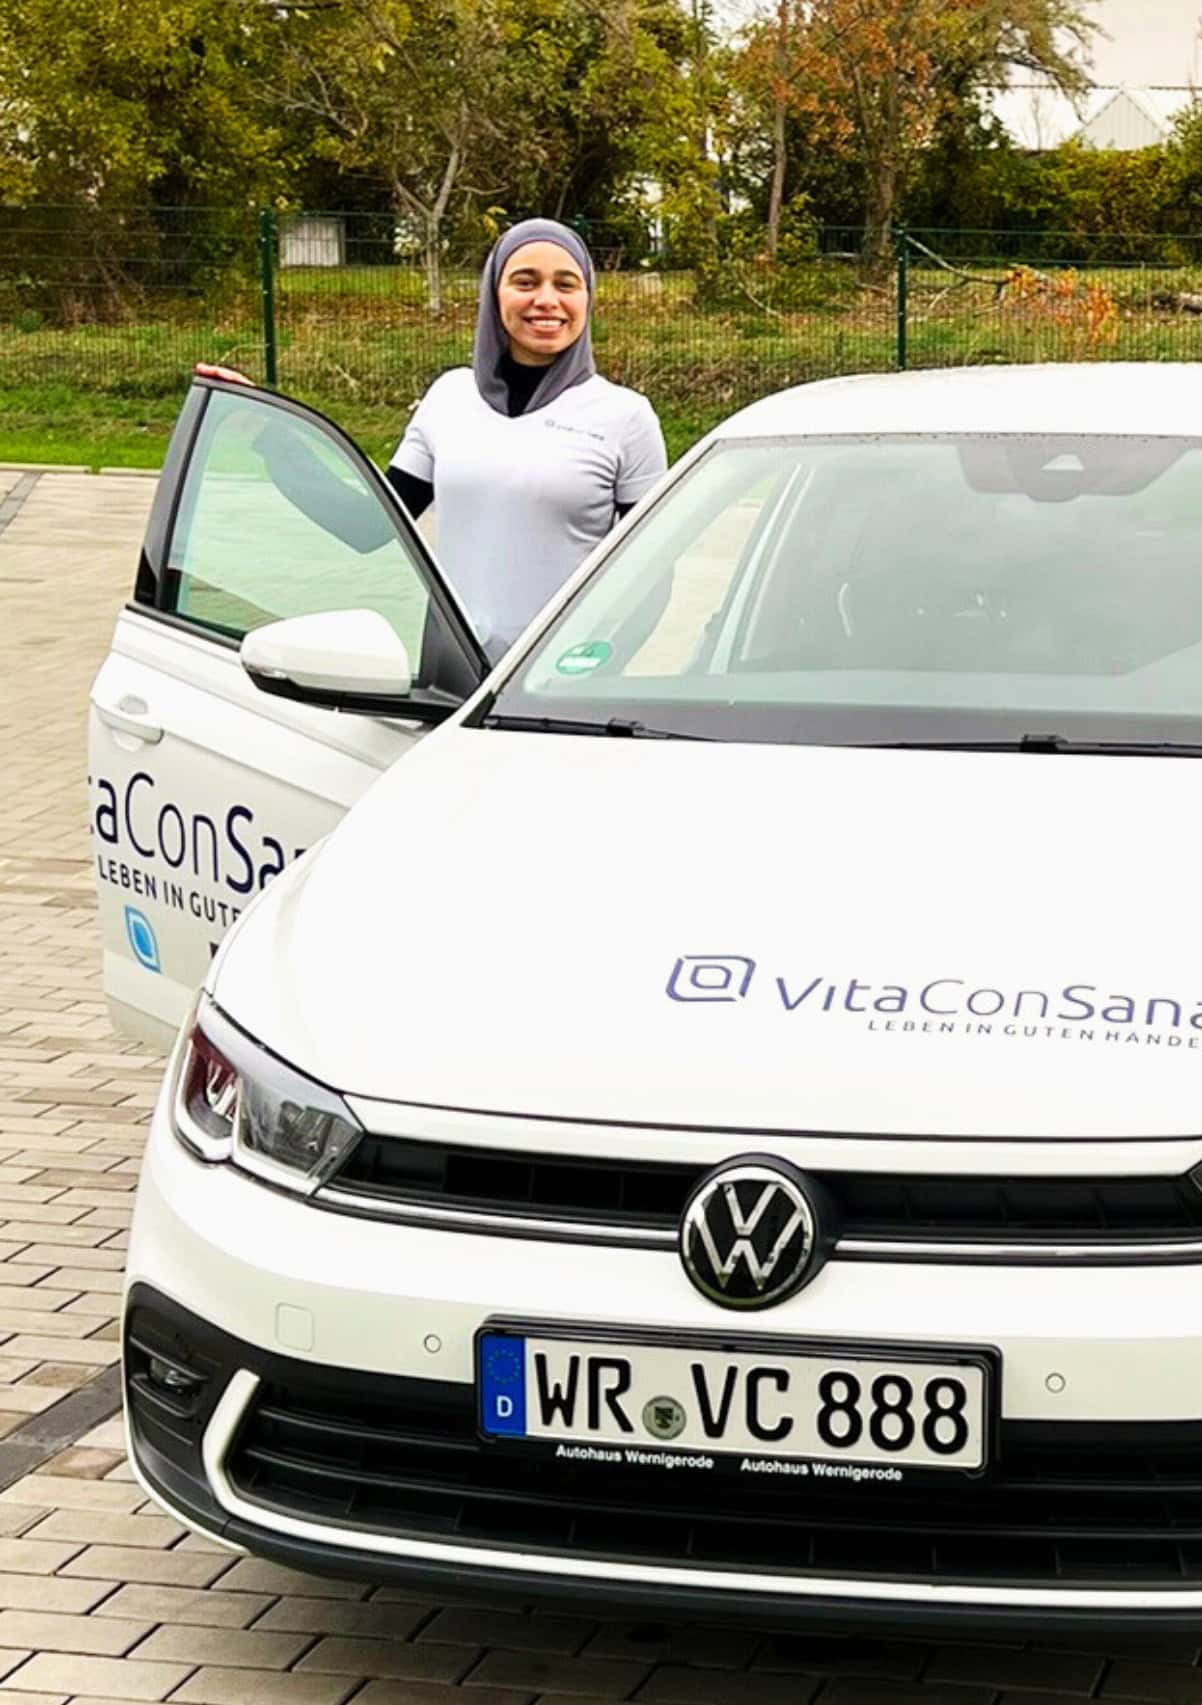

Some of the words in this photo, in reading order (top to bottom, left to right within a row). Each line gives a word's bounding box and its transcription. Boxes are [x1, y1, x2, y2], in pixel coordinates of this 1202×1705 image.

[97, 854, 158, 900] LEBEN
[163, 880, 184, 911] IN
[867, 1019, 955, 1033] LEBEN
[965, 1022, 992, 1034] IN
[1003, 1024, 1096, 1041] GUTEN
[496, 1395, 513, 1418] D
[534, 1352, 634, 1433] WR
[691, 1362, 794, 1441] VC
[816, 1371, 969, 1455] 888
[555, 1444, 622, 1462] Autohaus
[625, 1450, 714, 1470] Wernigerode
[740, 1457, 809, 1475] Autohaus
[812, 1462, 903, 1482] Wernigerode
